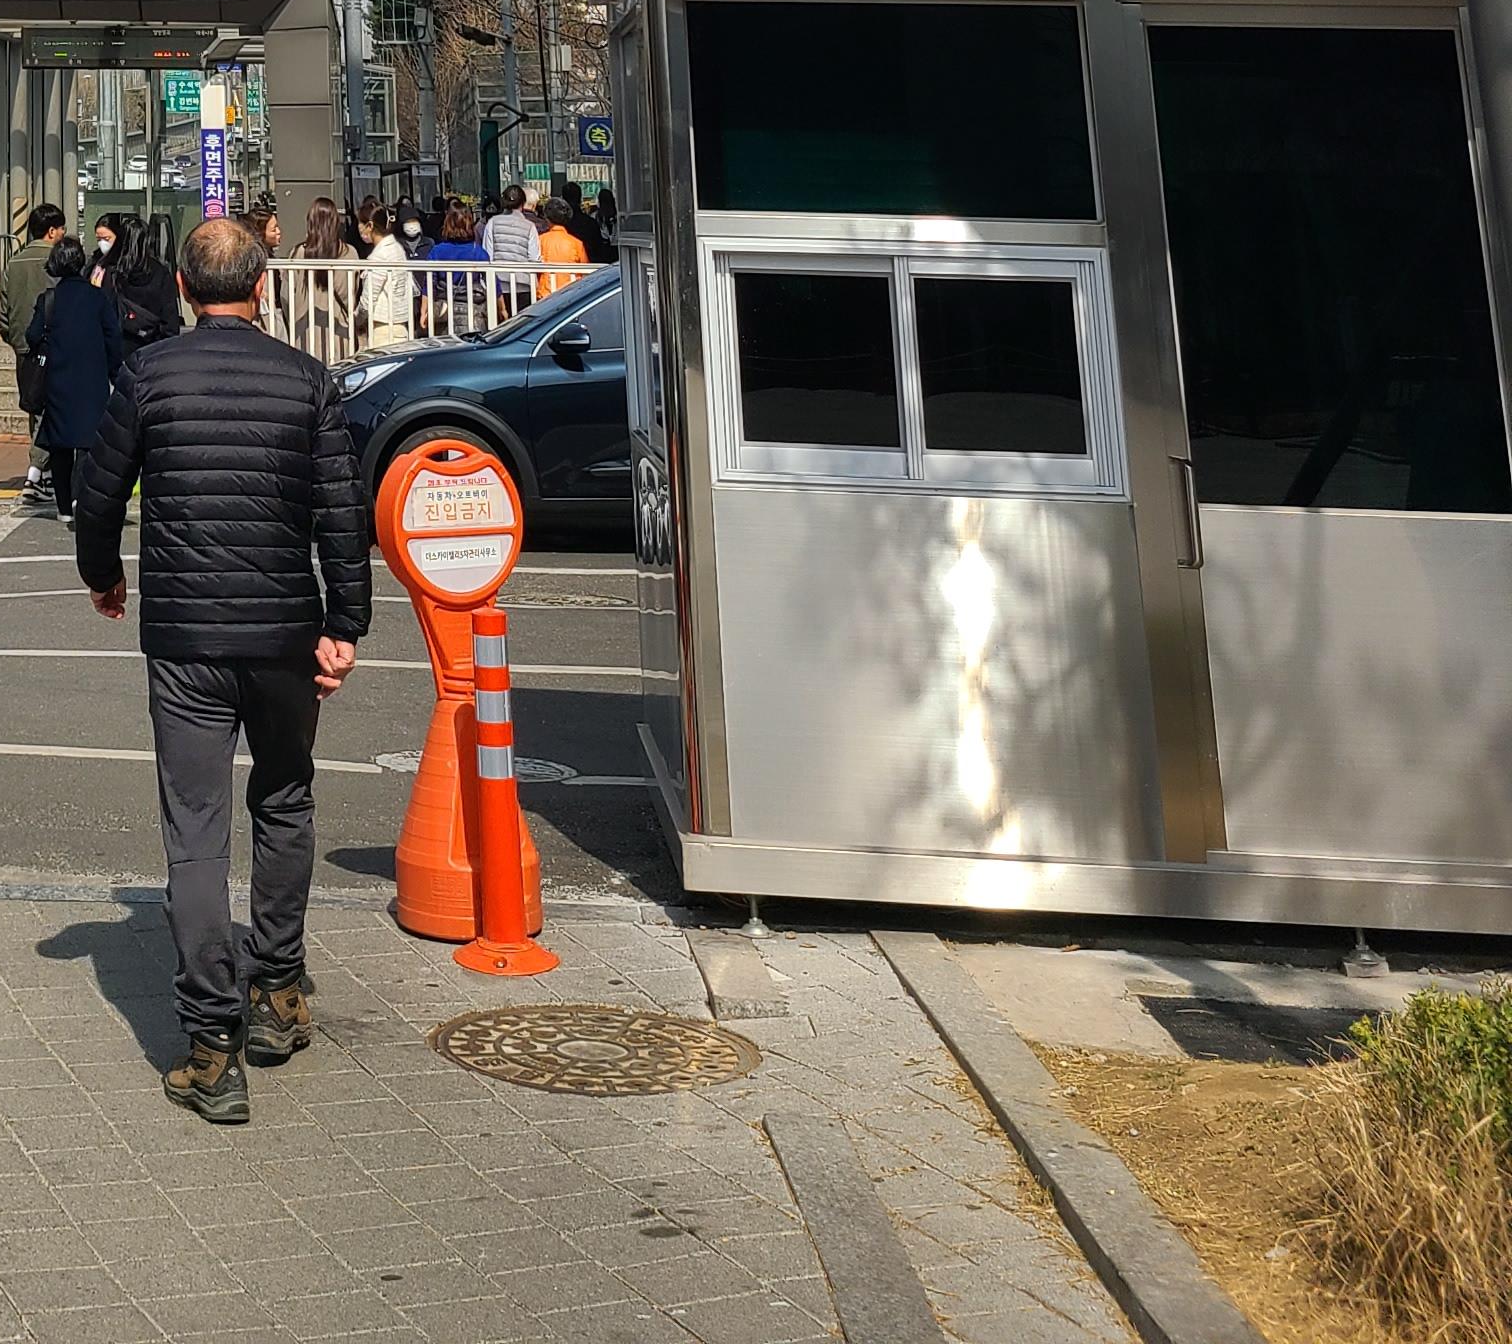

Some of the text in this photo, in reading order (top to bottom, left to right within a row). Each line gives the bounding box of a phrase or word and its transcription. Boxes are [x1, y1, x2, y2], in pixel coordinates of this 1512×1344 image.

[591, 127, 608, 147] 축
[203, 133, 224, 200] 후면주차
[424, 500, 491, 522] 진입금지
